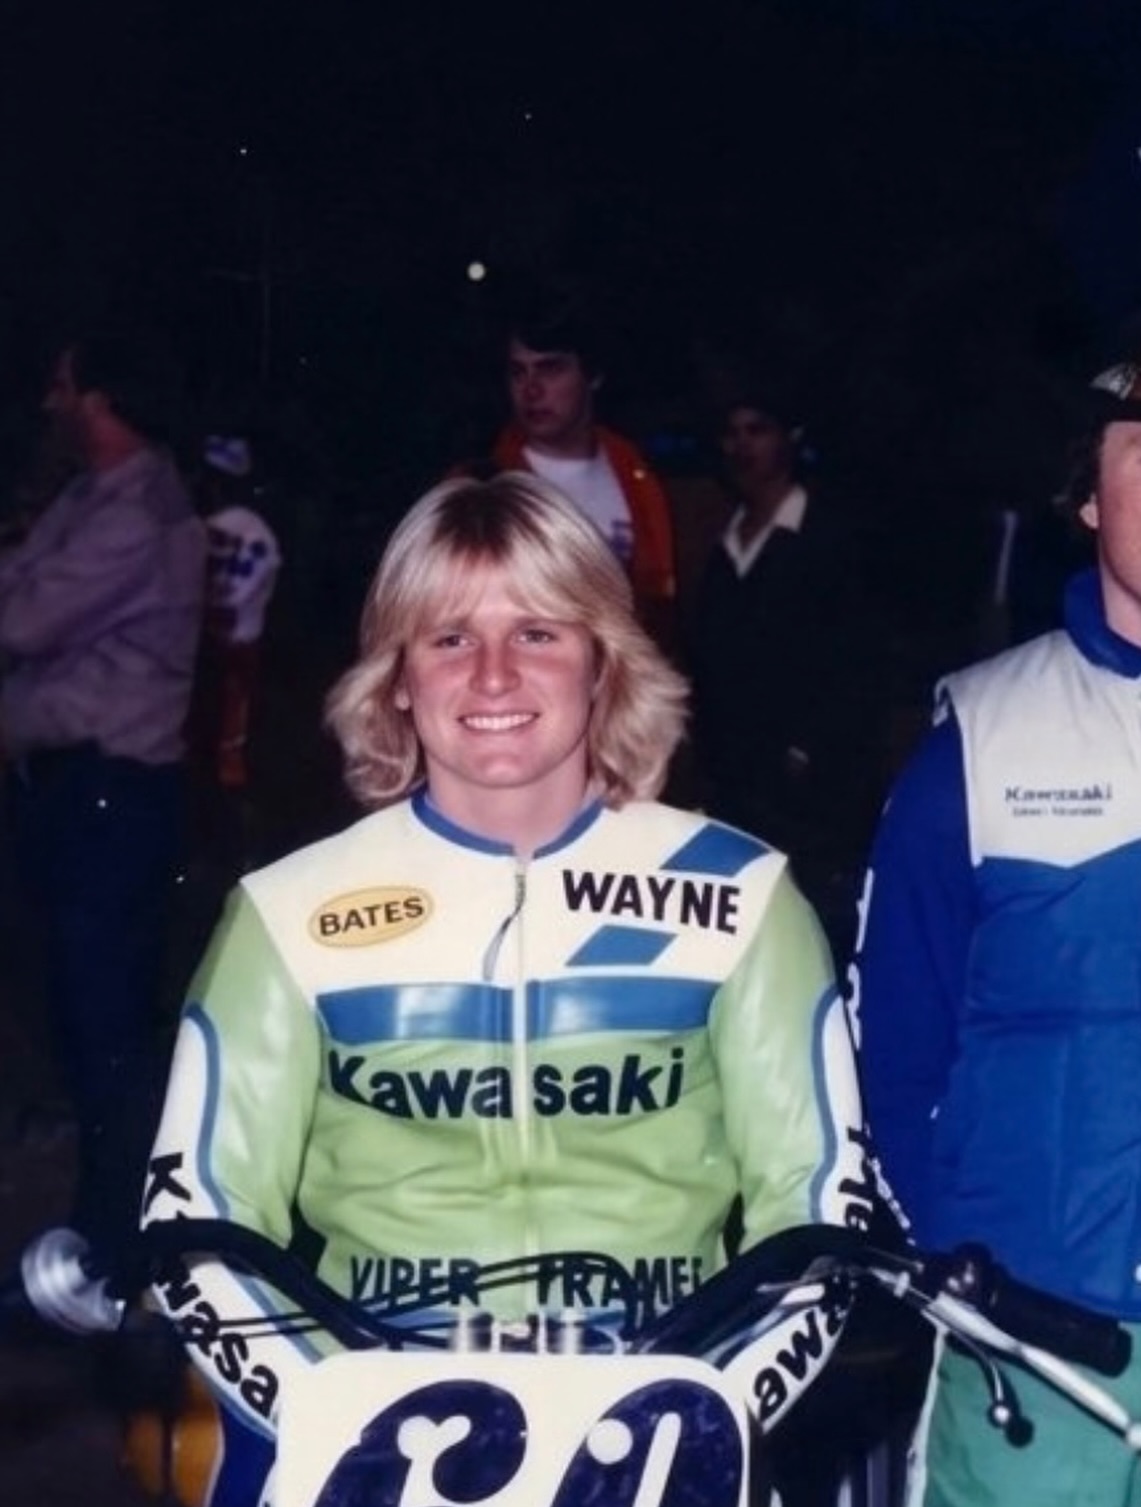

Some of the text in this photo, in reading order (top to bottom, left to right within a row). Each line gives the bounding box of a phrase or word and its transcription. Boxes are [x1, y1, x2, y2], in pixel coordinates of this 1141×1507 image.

[319, 896, 424, 936] BATES
[562, 869, 741, 935] WAYNE
[350, 1255, 480, 1307] VIPER
